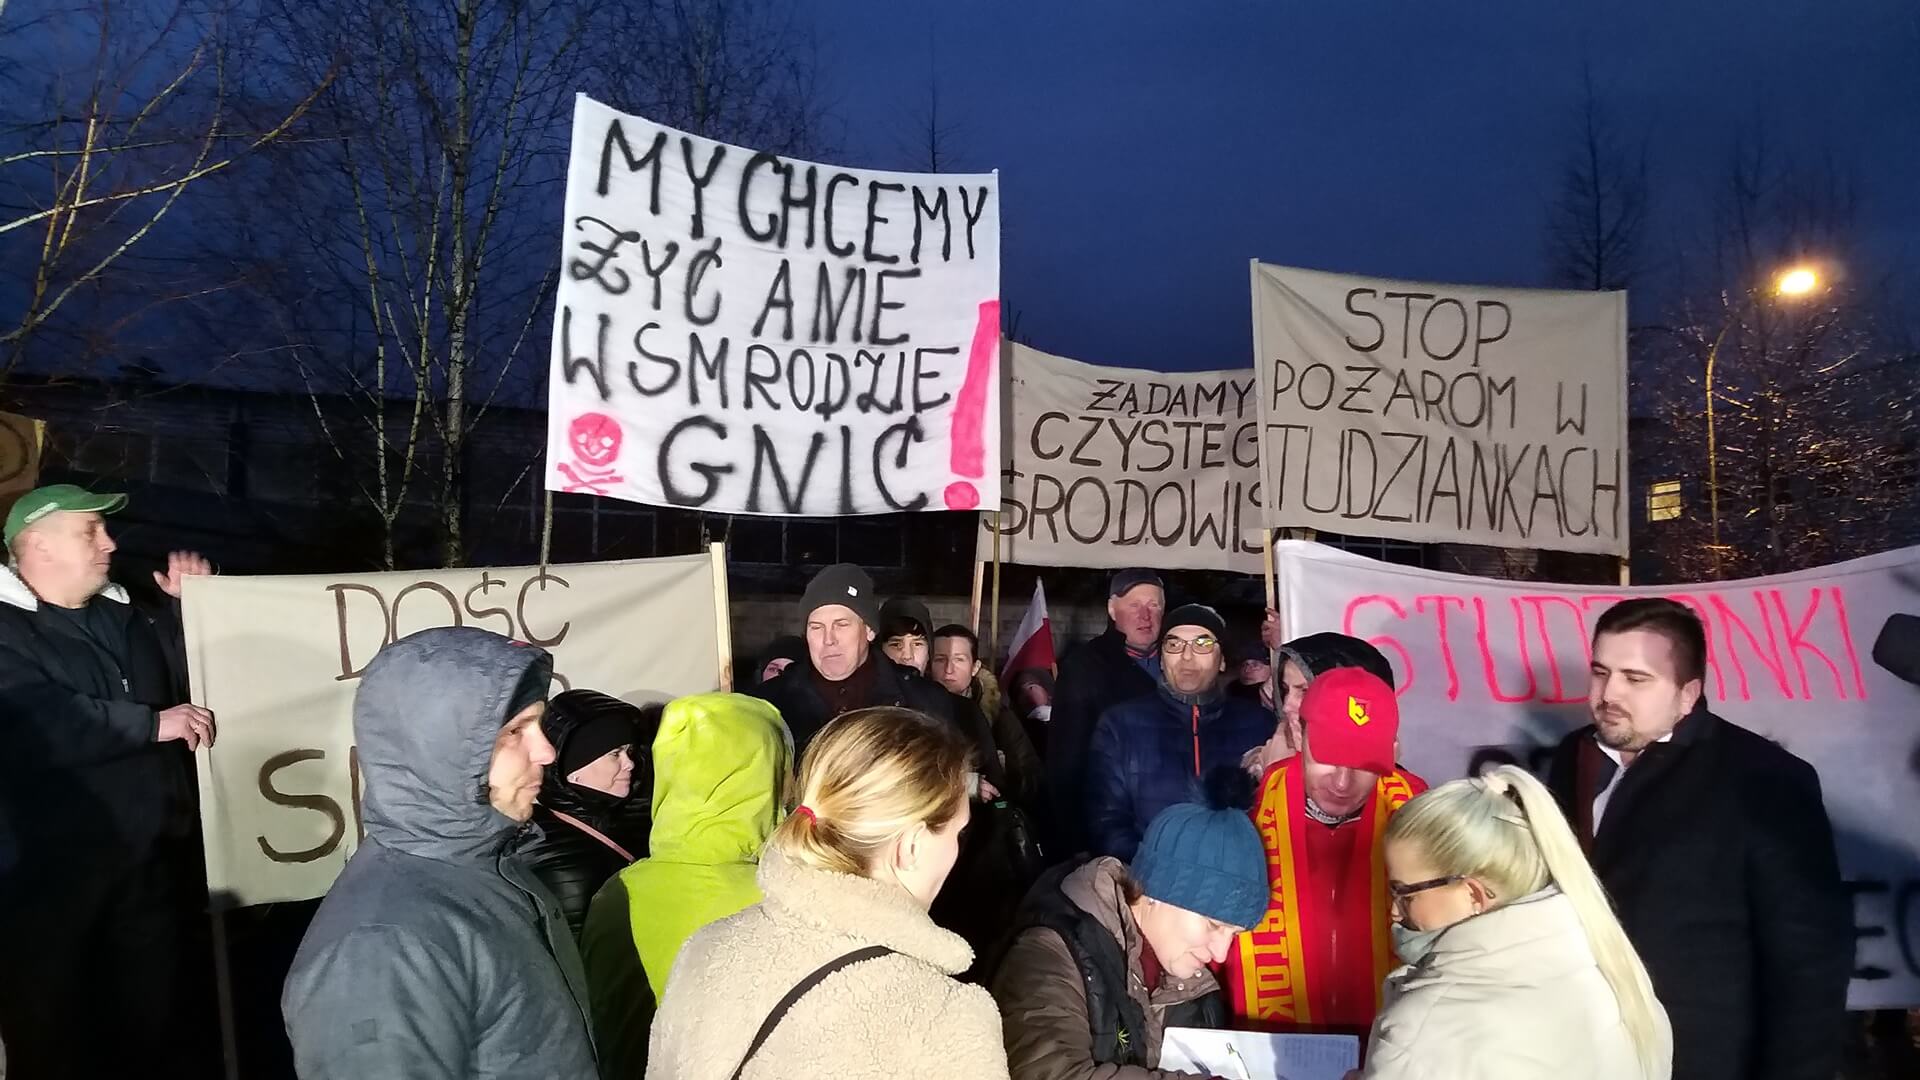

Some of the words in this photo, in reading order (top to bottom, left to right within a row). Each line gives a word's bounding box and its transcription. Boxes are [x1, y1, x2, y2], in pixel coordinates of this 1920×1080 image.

[597, 119, 727, 240] MY
[737, 152, 989, 264] CHCEMY
[561, 305, 612, 400] W
[627, 322, 960, 422] SMRODZIE
[1345, 287, 1512, 367] STOP
[1086, 378, 1256, 419] ŻĄDAMY
[1556, 382, 1587, 435] W
[325, 565, 570, 681] DOŚĆ
